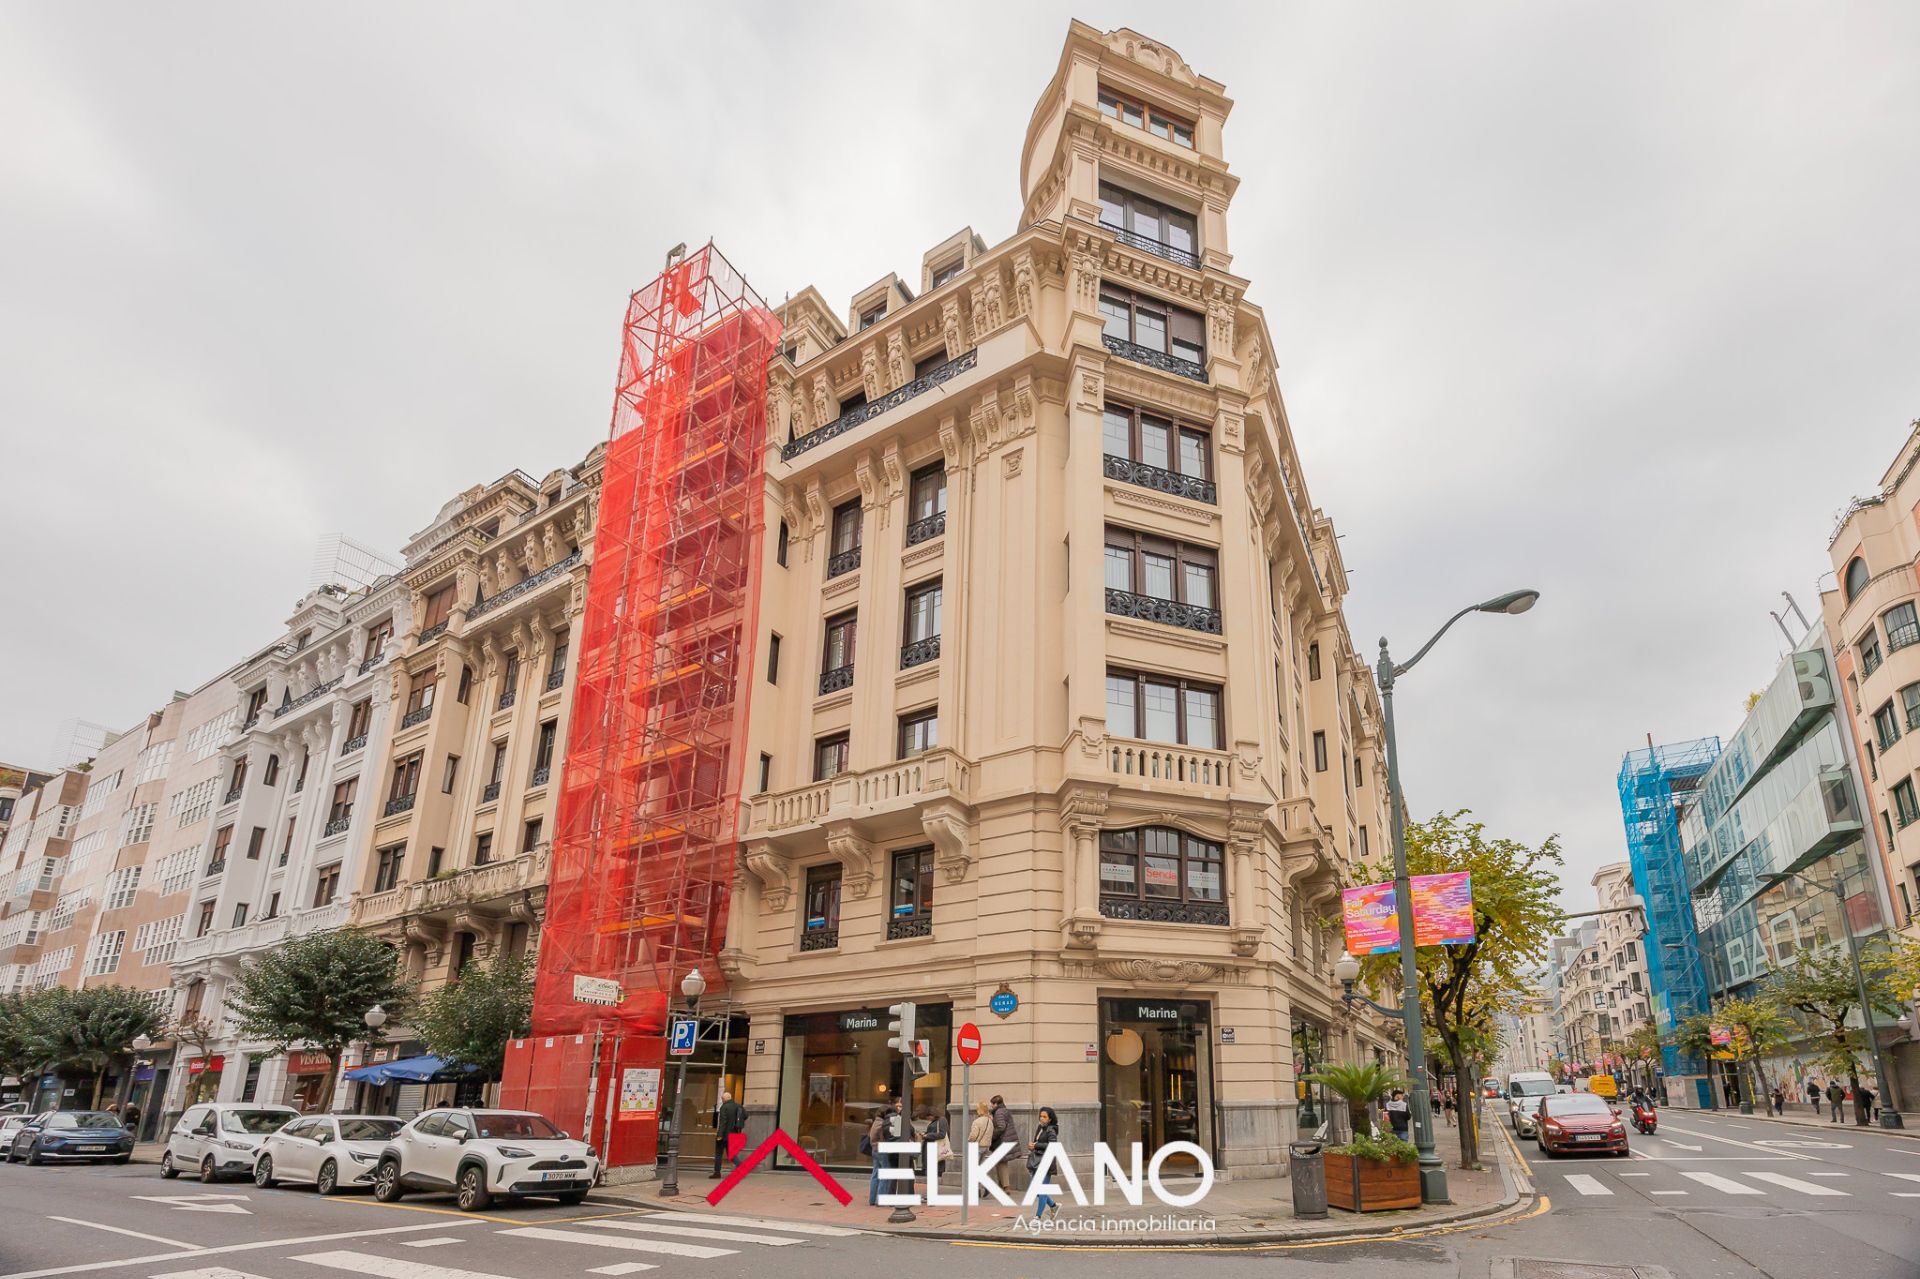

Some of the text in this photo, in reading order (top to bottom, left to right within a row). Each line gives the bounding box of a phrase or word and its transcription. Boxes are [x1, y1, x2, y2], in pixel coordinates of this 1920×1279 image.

[1345, 898, 1364, 909] Fair
[1345, 904, 1397, 919] Saturday
[1138, 1006, 1178, 1019] Marina
[846, 1017, 878, 1029] Marina
[673, 1023, 689, 1048] P
